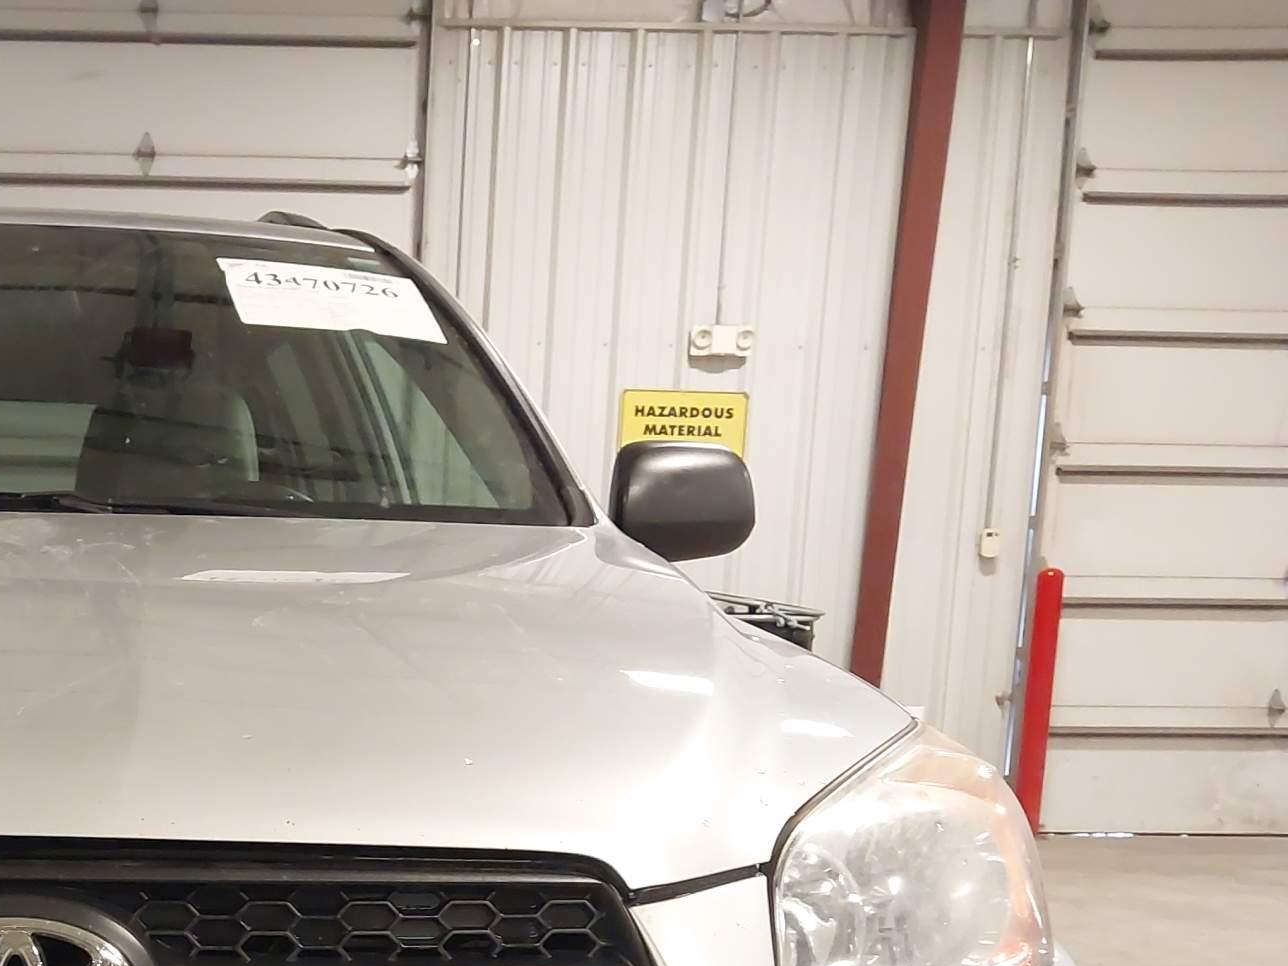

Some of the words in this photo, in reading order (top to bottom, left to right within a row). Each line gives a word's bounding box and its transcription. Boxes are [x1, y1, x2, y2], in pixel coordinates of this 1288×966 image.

[244, 271, 400, 299] 43470726
[634, 405, 735, 419] HAZARDOUS
[643, 424, 722, 437] MATERIAL
